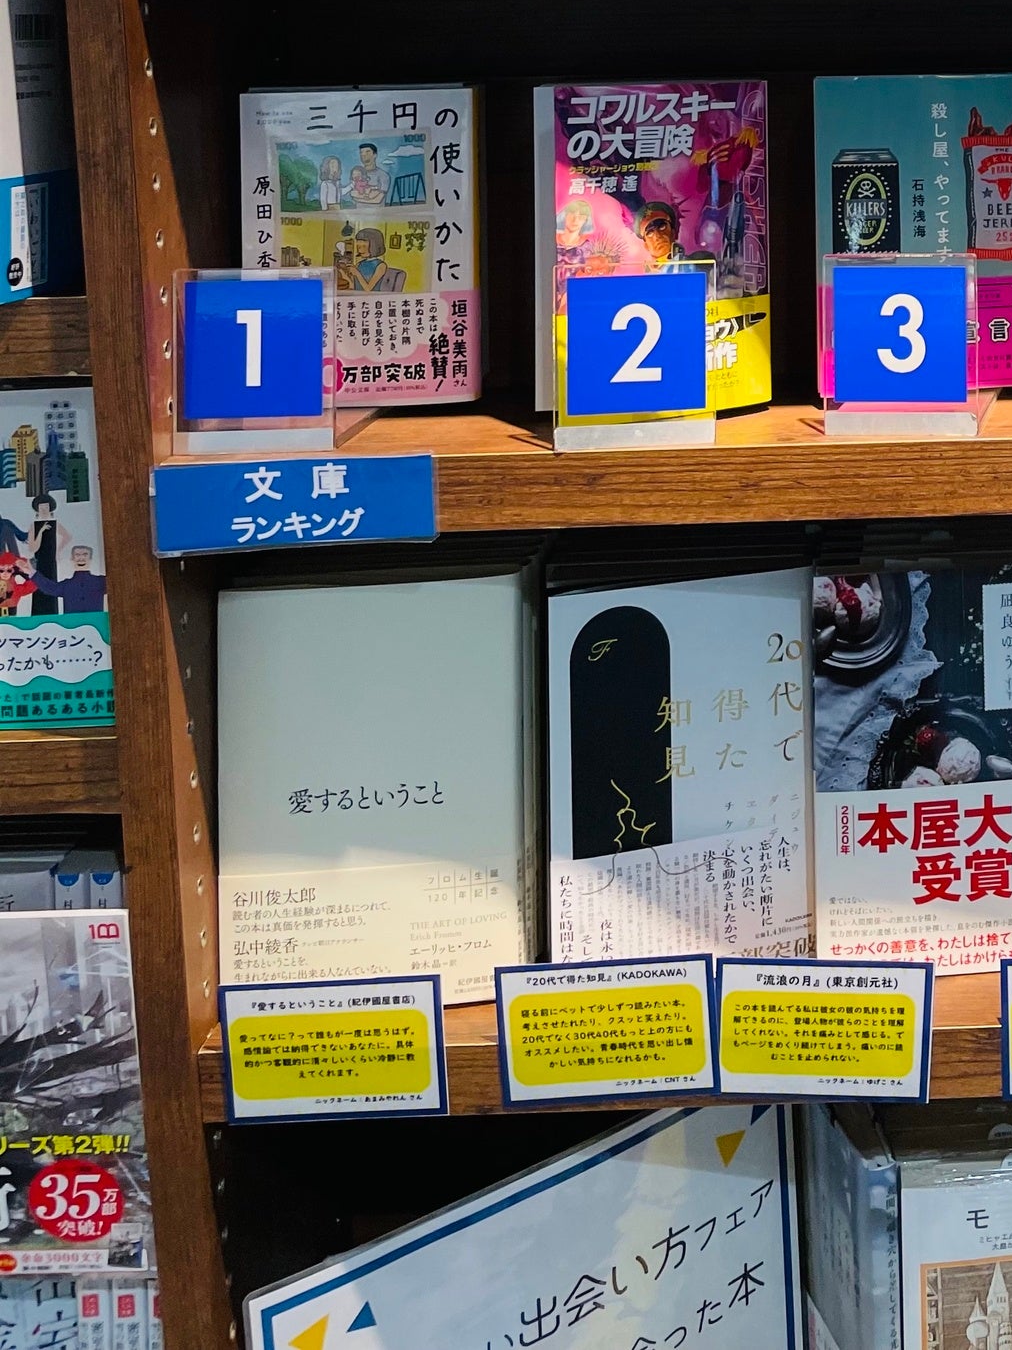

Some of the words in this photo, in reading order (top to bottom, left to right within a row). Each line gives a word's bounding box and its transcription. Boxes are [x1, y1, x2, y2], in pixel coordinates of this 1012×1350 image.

[306, 99, 459, 134] 三千円の
[566, 91, 736, 126] コワルスキー
[403, 134, 427, 143] 1000
[566, 125, 696, 160] の大冒険
[568, 175, 618, 196] 高千穂
[252, 175, 278, 271] 原田ひ香
[280, 217, 303, 226] 1000
[429, 142, 464, 284] 使いかた
[845, 201, 887, 218] KILLERS
[911, 178, 927, 238] 石持浅海
[361, 301, 371, 346] たびに再び
[374, 300, 384, 356] 自分を見失う
[401, 299, 411, 345] 本棚の片隅
[415, 298, 424, 335] 死ぬまで
[876, 293, 927, 374] 3
[235, 309, 263, 388] 1
[609, 302, 663, 383] 2
[342, 362, 426, 384] 万部突破
[243, 462, 350, 503] 文庫
[230, 506, 365, 543] ランキング
[766, 631, 806, 763] 20代で
[653, 695, 696, 784] 知見
[713, 687, 749, 771] 得た
[288, 781, 446, 816] 愛するということ
[839, 805, 851, 855] 2020年
[777, 835, 793, 873] 人生は、
[233, 887, 317, 908] 谷川俊太郎
[741, 845, 756, 913] いくつ出会い、
[410, 921, 430, 932] THE
[431, 919, 452, 930] ART
[454, 917, 468, 927] OF
[470, 911, 508, 926] LOVING
[233, 937, 299, 957] 弘中綾香
[410, 939, 492, 957] エーリッヒ・フロム
[298, 1067, 361, 1079] えてくれます。
[549, 1054, 669, 1069] かしい気持ちになれるかも。
[770, 1053, 861, 1063] むことを止められない。
[35, 1173, 102, 1220] 35
[101, 1188, 119, 1216] 万部
[56, 1220, 104, 1238] 突破!
